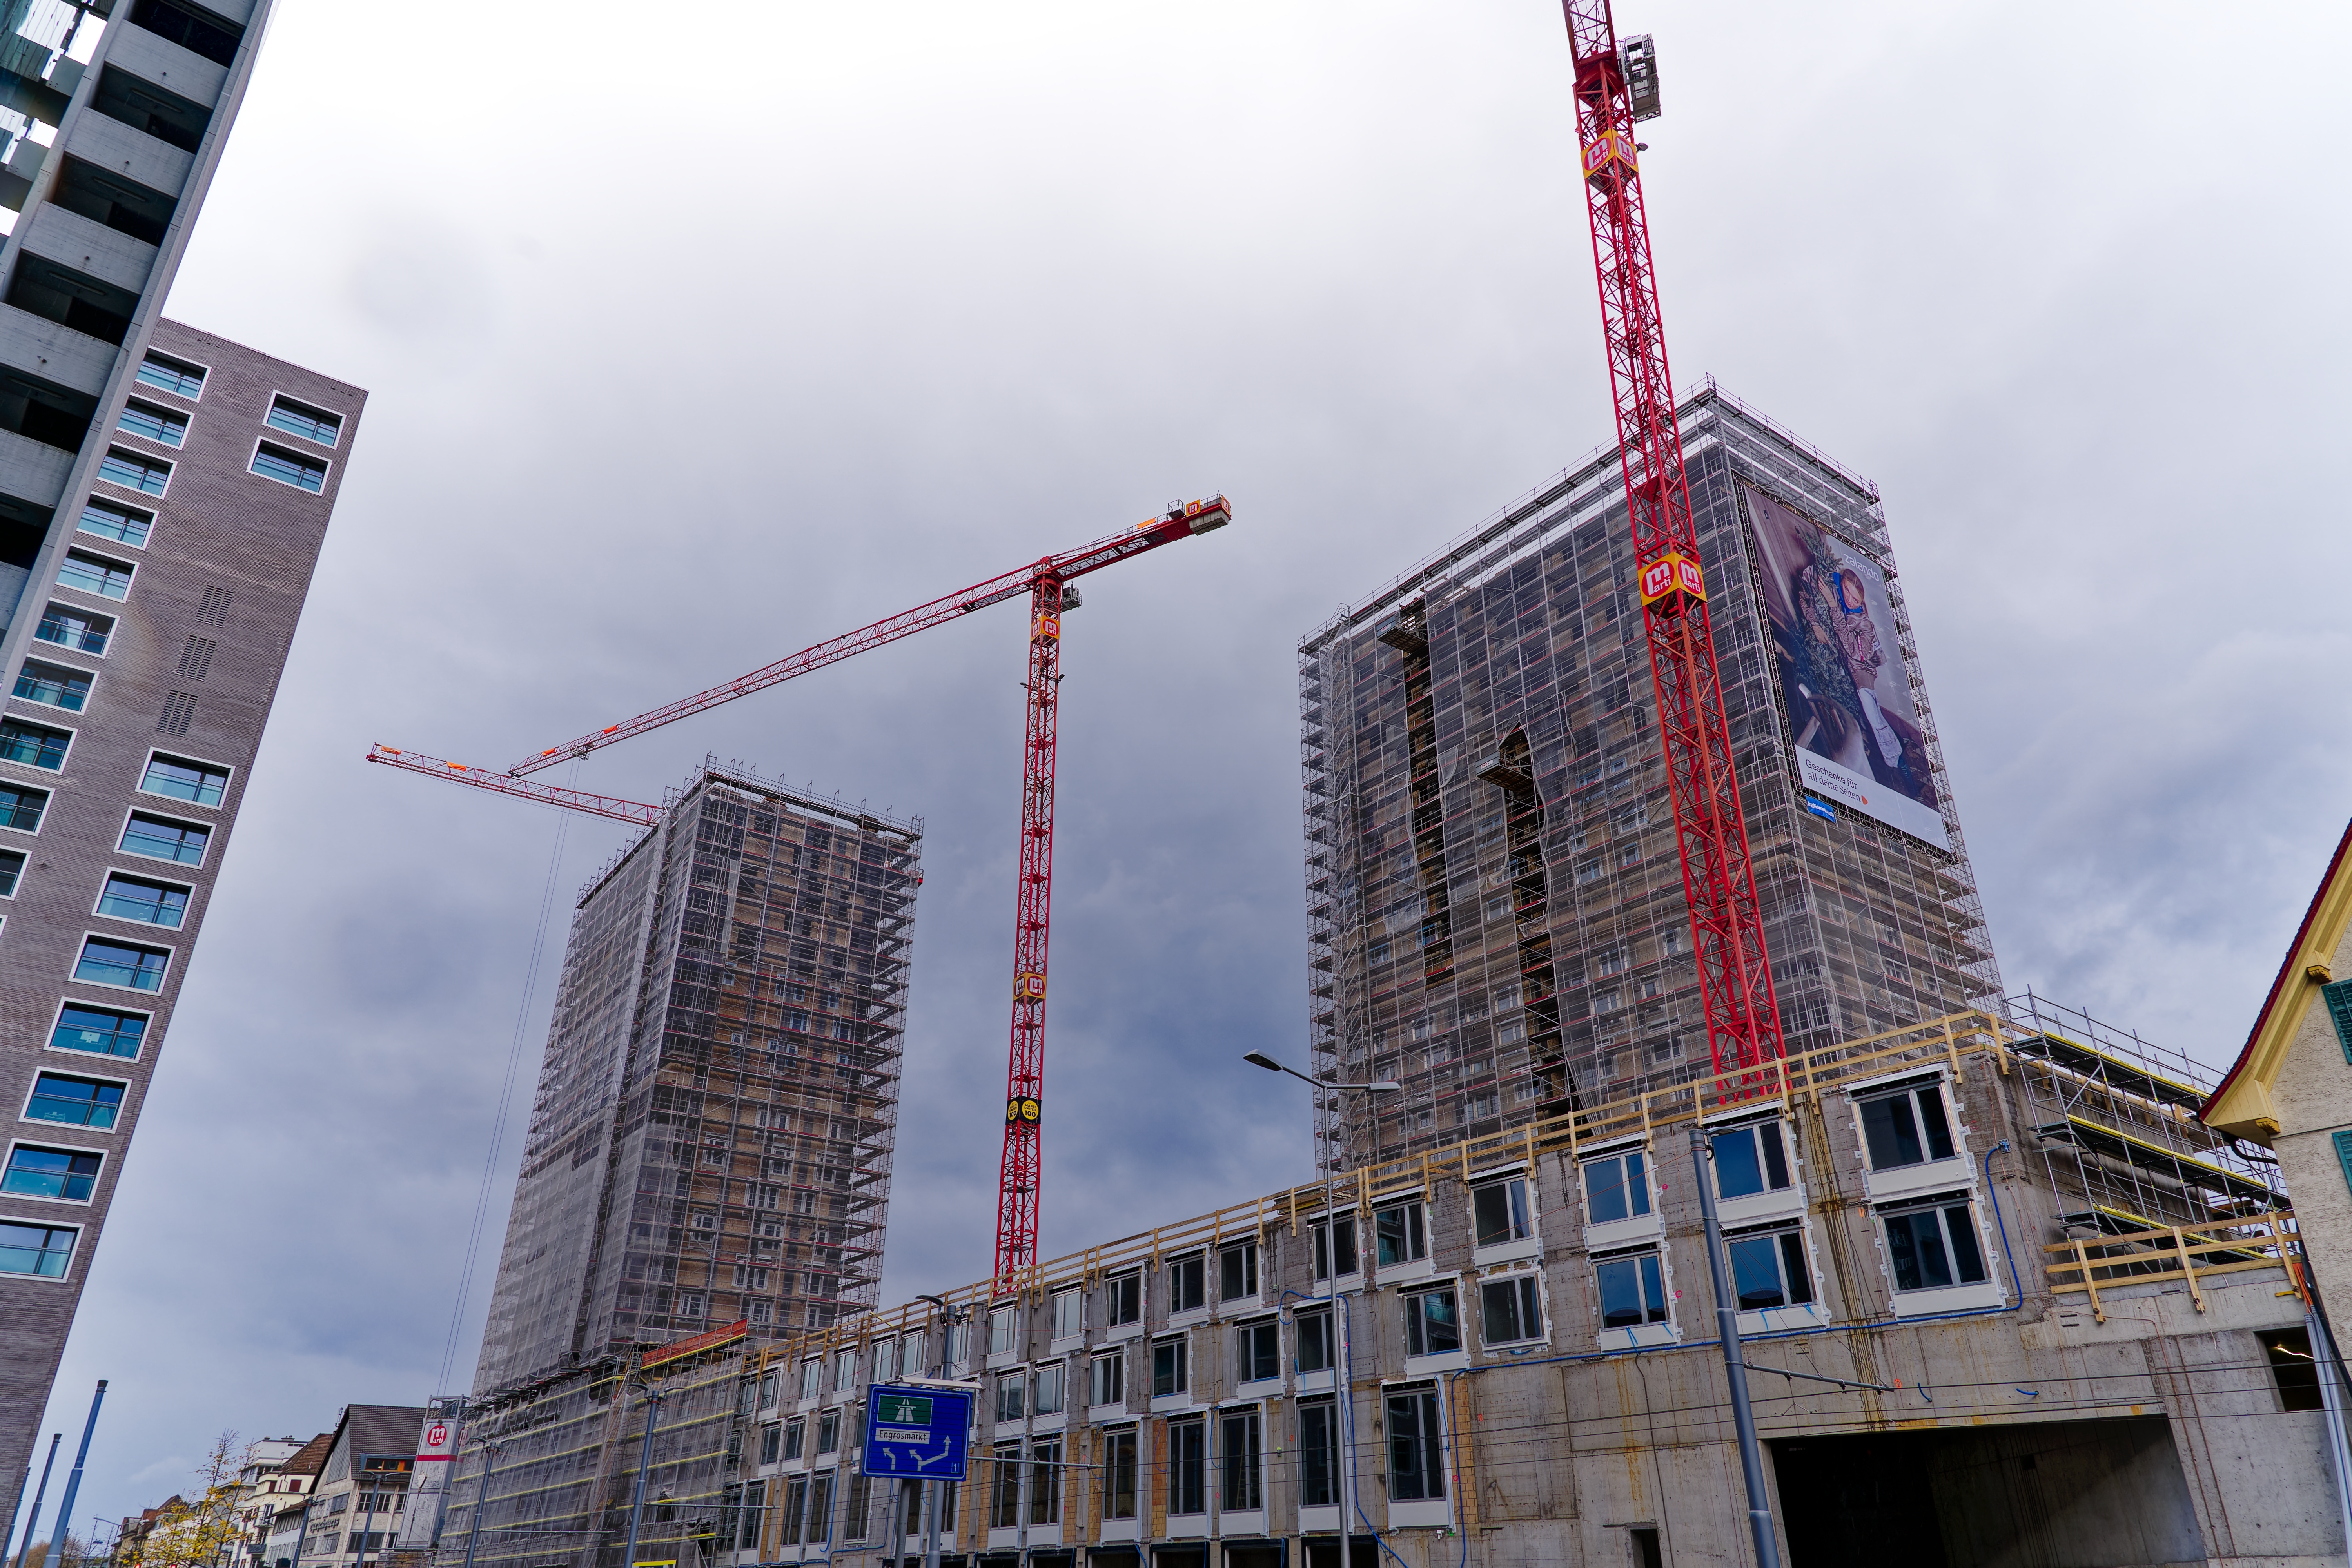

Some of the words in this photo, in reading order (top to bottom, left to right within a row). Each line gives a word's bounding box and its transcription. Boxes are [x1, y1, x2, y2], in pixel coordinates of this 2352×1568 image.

[1587, 138, 1609, 170] marti
[1617, 137, 1634, 165] marti
[1646, 563, 1671, 596] marti
[1680, 561, 1701, 593] marti
[1844, 553, 1879, 582] zalando
[1045, 620, 1056, 635] marti
[1805, 759, 1846, 784] Geschenke
[1846, 777, 1857, 790] für
[1808, 772, 1818, 782] all
[1819, 776, 1838, 791] deine
[1839, 785, 1861, 802] Seiten
[1029, 977, 1042, 995] marti
[429, 1428, 445, 1443] marti
[879, 1430, 926, 1441] Engrosmarkt
[953, 1463, 957, 1472] 1
